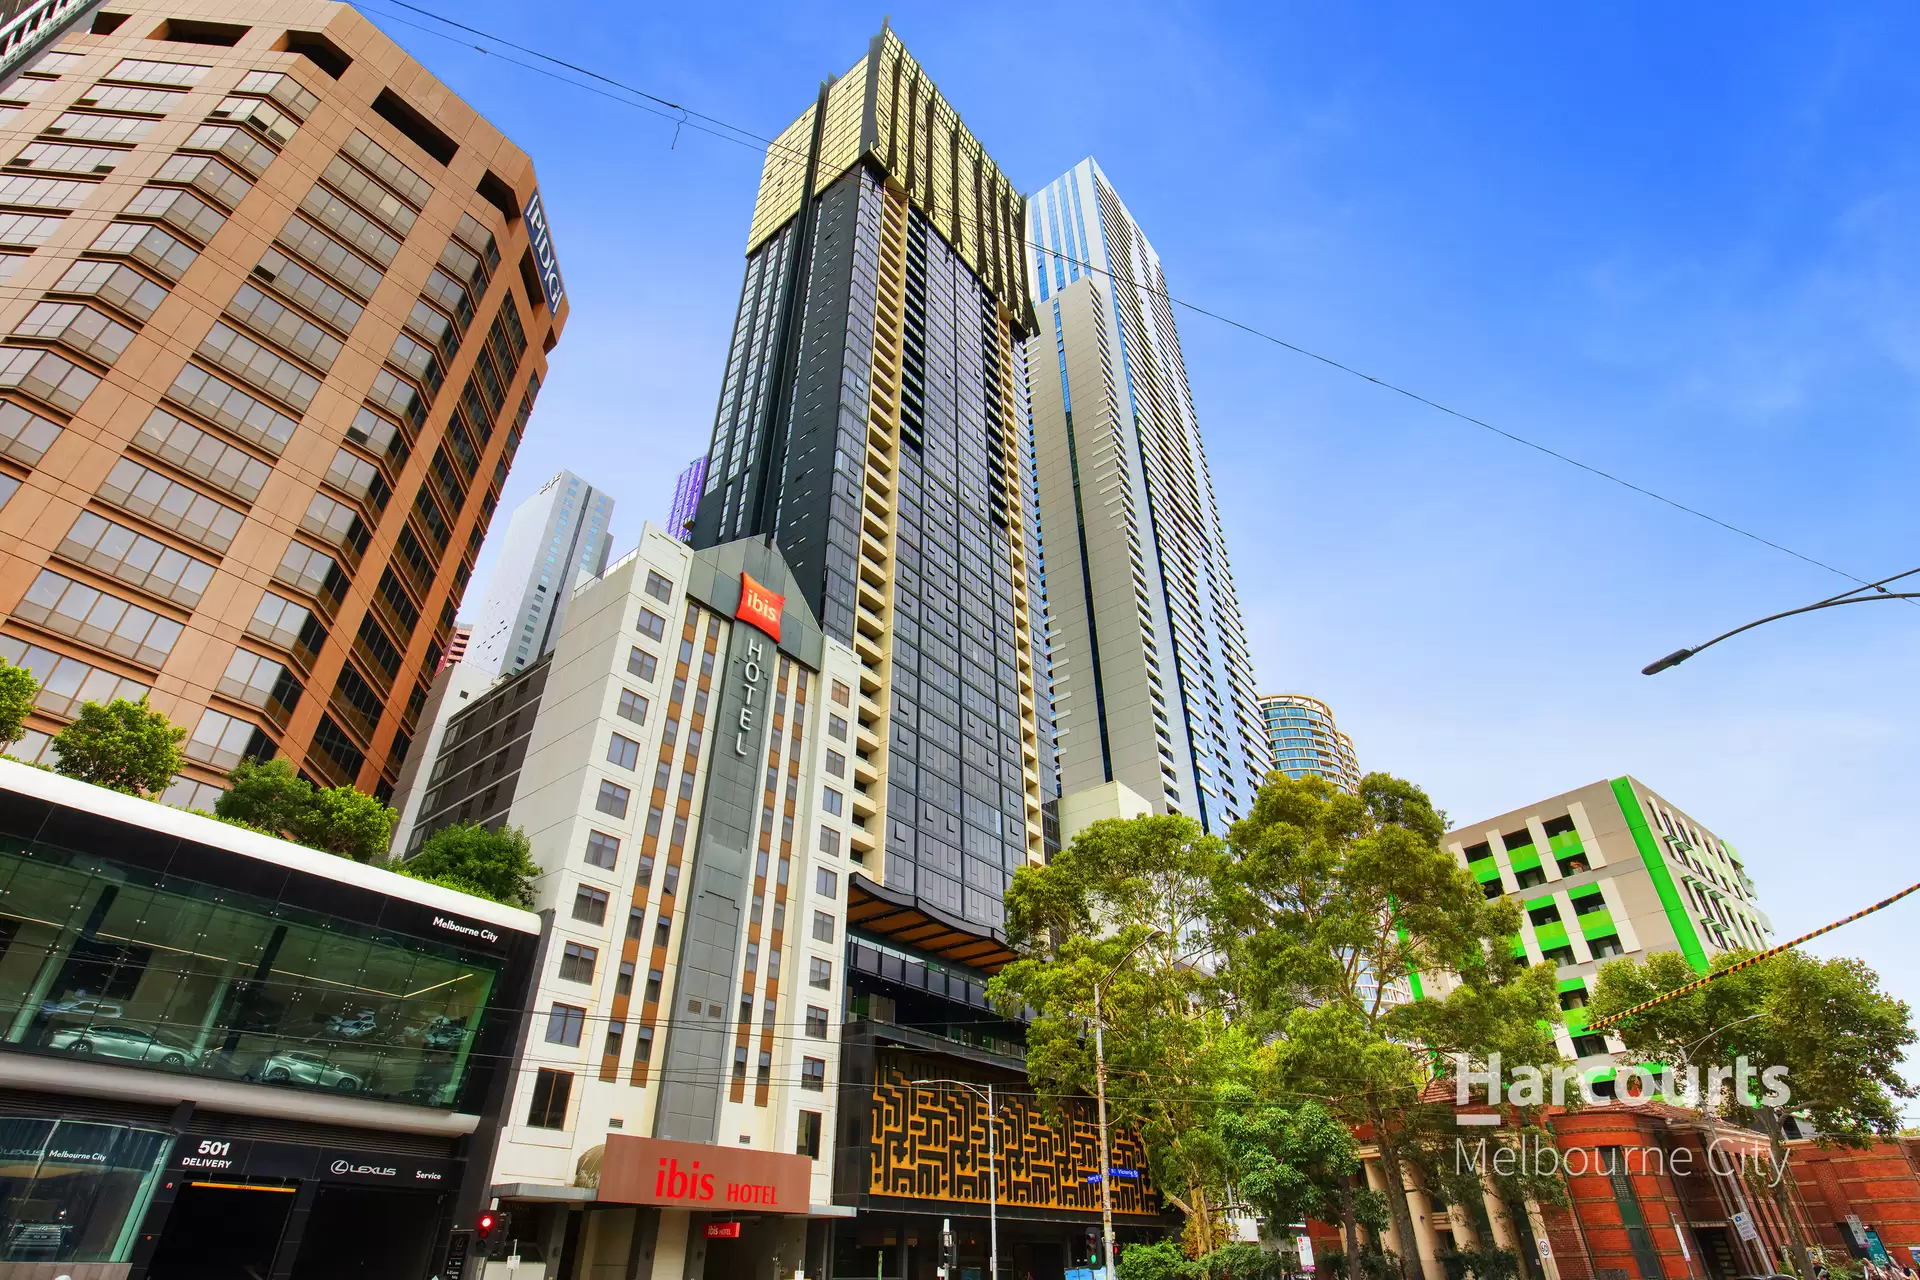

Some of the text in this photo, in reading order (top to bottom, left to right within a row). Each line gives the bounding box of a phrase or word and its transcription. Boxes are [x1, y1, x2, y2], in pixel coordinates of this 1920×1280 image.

[746, 589, 777, 622] ibis
[736, 638, 762, 756] HOTEL
[433, 916, 499, 943] Melbourne City
[48, 1149, 90, 1160] Melbourne
[91, 1152, 107, 1162] City
[197, 1140, 231, 1157] 501
[181, 1157, 233, 1169] DELIVERY
[349, 1164, 442, 1180] LEXUS Service
[655, 1157, 778, 1205] ibis HOTEL
[707, 1225, 719, 1236] ibis
